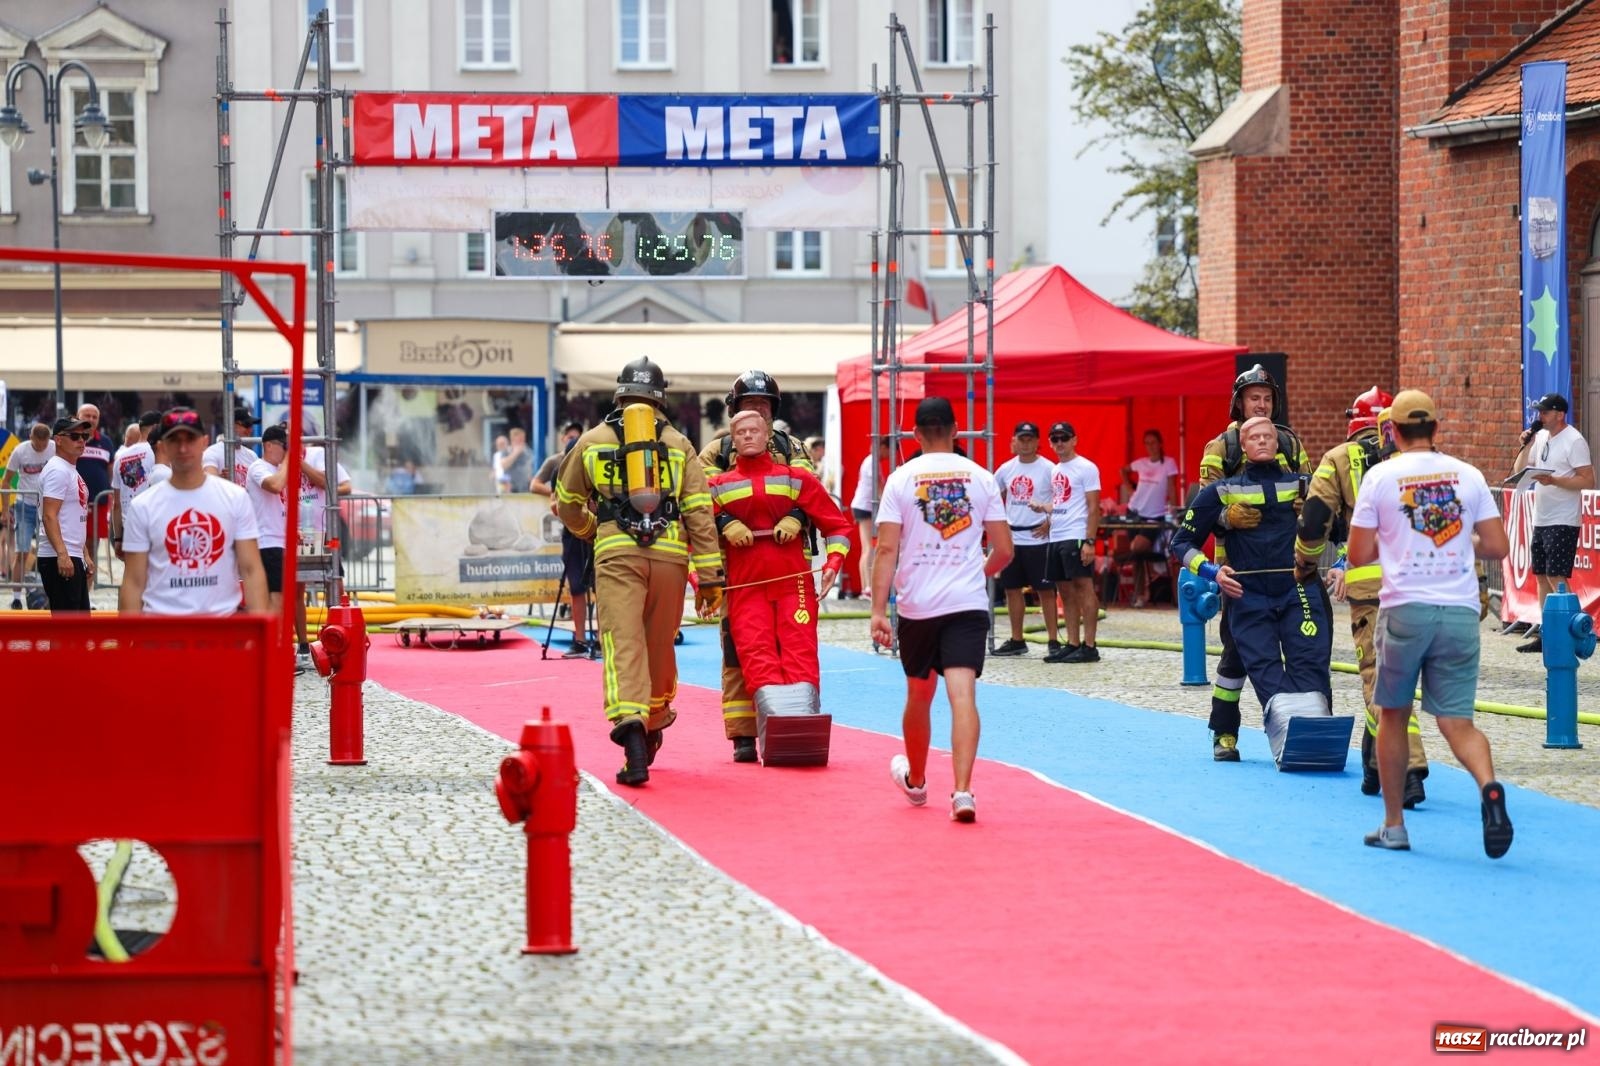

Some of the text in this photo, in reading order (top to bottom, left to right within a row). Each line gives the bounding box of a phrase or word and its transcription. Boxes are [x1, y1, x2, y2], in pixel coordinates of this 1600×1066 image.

[393, 103, 577, 160] META
[665, 105, 847, 160] META
[514, 234, 613, 261] 1:25.76
[638, 234, 735, 261] 1:25.76
[466, 561, 531, 577] hurtownia
